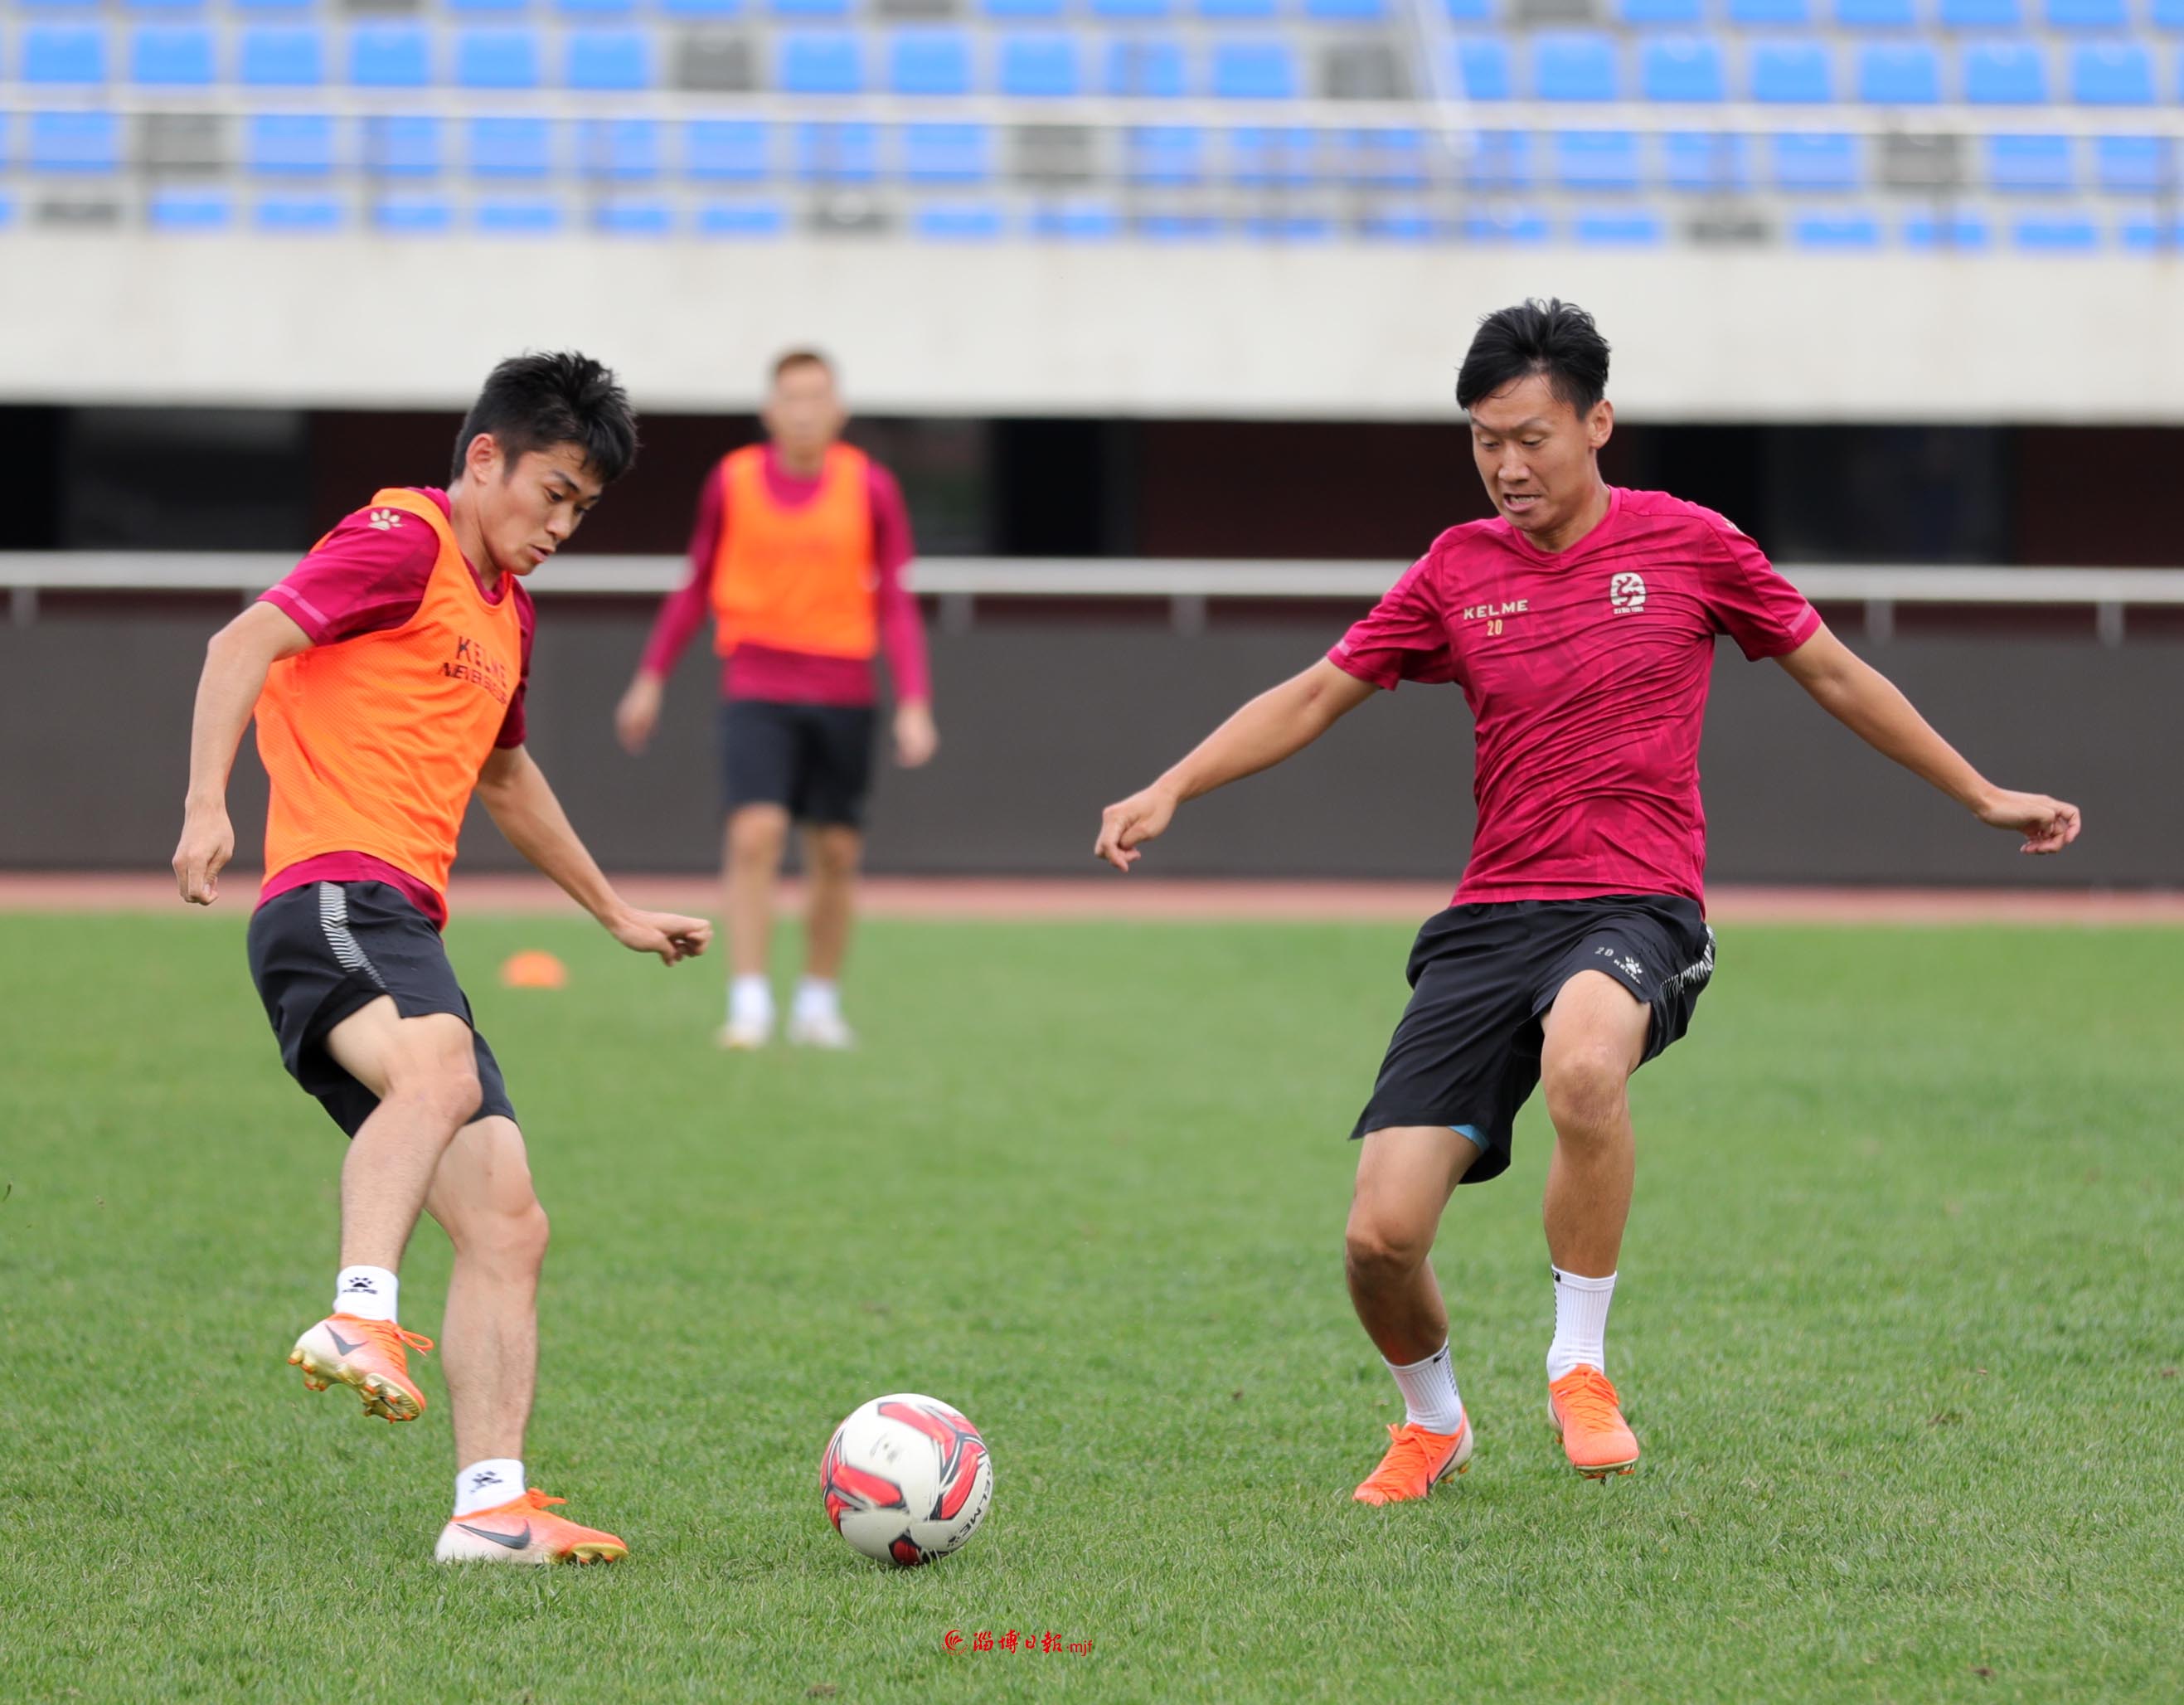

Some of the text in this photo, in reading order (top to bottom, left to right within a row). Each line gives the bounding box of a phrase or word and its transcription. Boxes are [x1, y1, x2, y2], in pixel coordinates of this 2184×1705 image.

[1463, 600, 1528, 620] KELME
[1487, 619, 1502, 636] 20
[1594, 946, 1614, 957] 20
